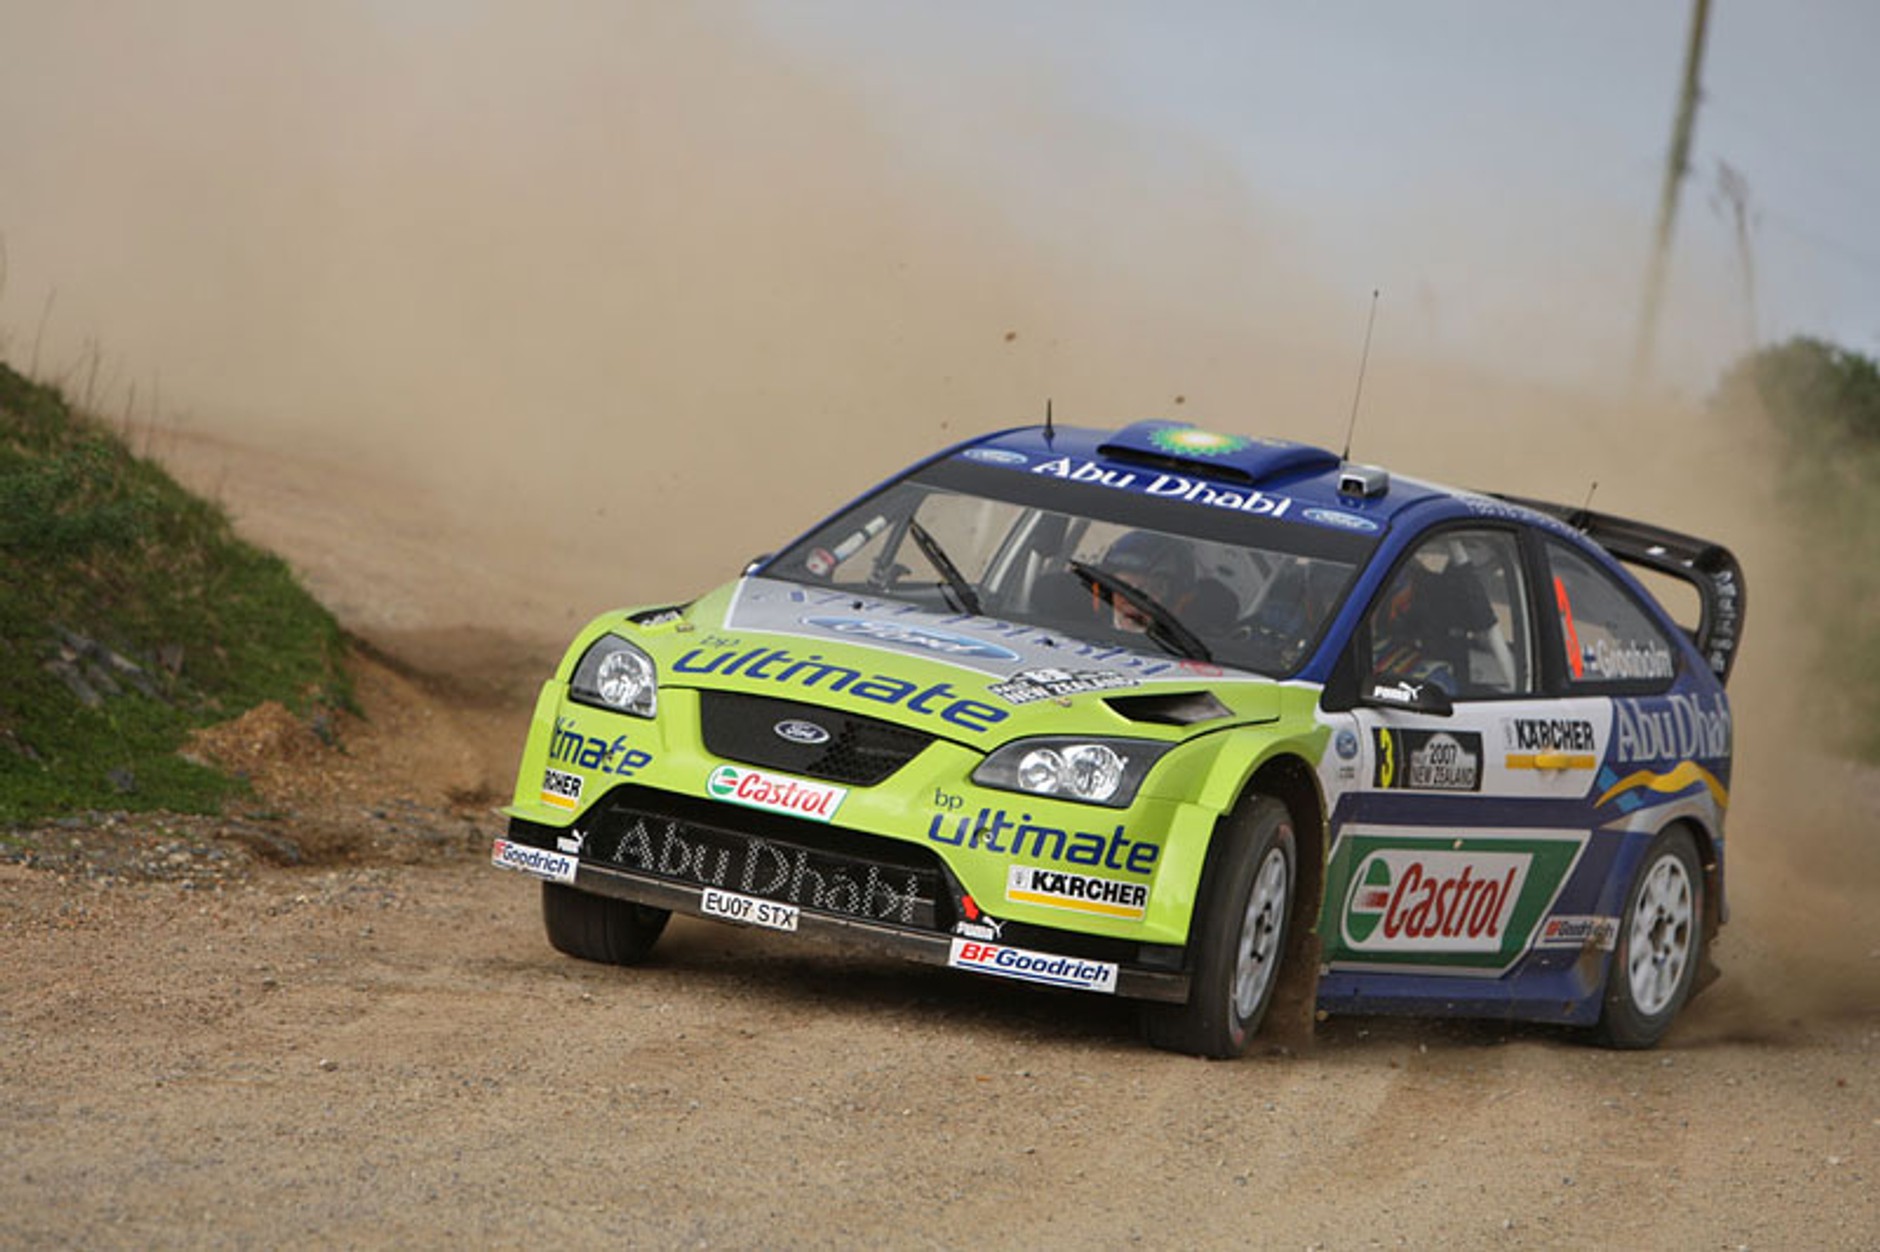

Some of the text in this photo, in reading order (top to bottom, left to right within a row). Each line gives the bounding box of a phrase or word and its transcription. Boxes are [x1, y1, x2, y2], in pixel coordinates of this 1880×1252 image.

[1032, 457, 1292, 517] Abu Dhabi
[672, 647, 1009, 732] ultimate
[1429, 742, 1458, 765] 2007
[1614, 698, 1677, 762] Abu
[1380, 727, 1394, 789] 3
[1411, 766, 1474, 786] NEW ZEALAND
[736, 773, 834, 816] Castrol
[934, 788, 964, 810] bp
[928, 806, 1160, 875] ultimate
[612, 818, 919, 923] Abu Dhabi
[1031, 870, 1148, 907] KÄRCHER
[704, 892, 794, 928] EU07 STX
[1384, 862, 1518, 939] Castrol
[959, 942, 1111, 983] BFGoodrich
